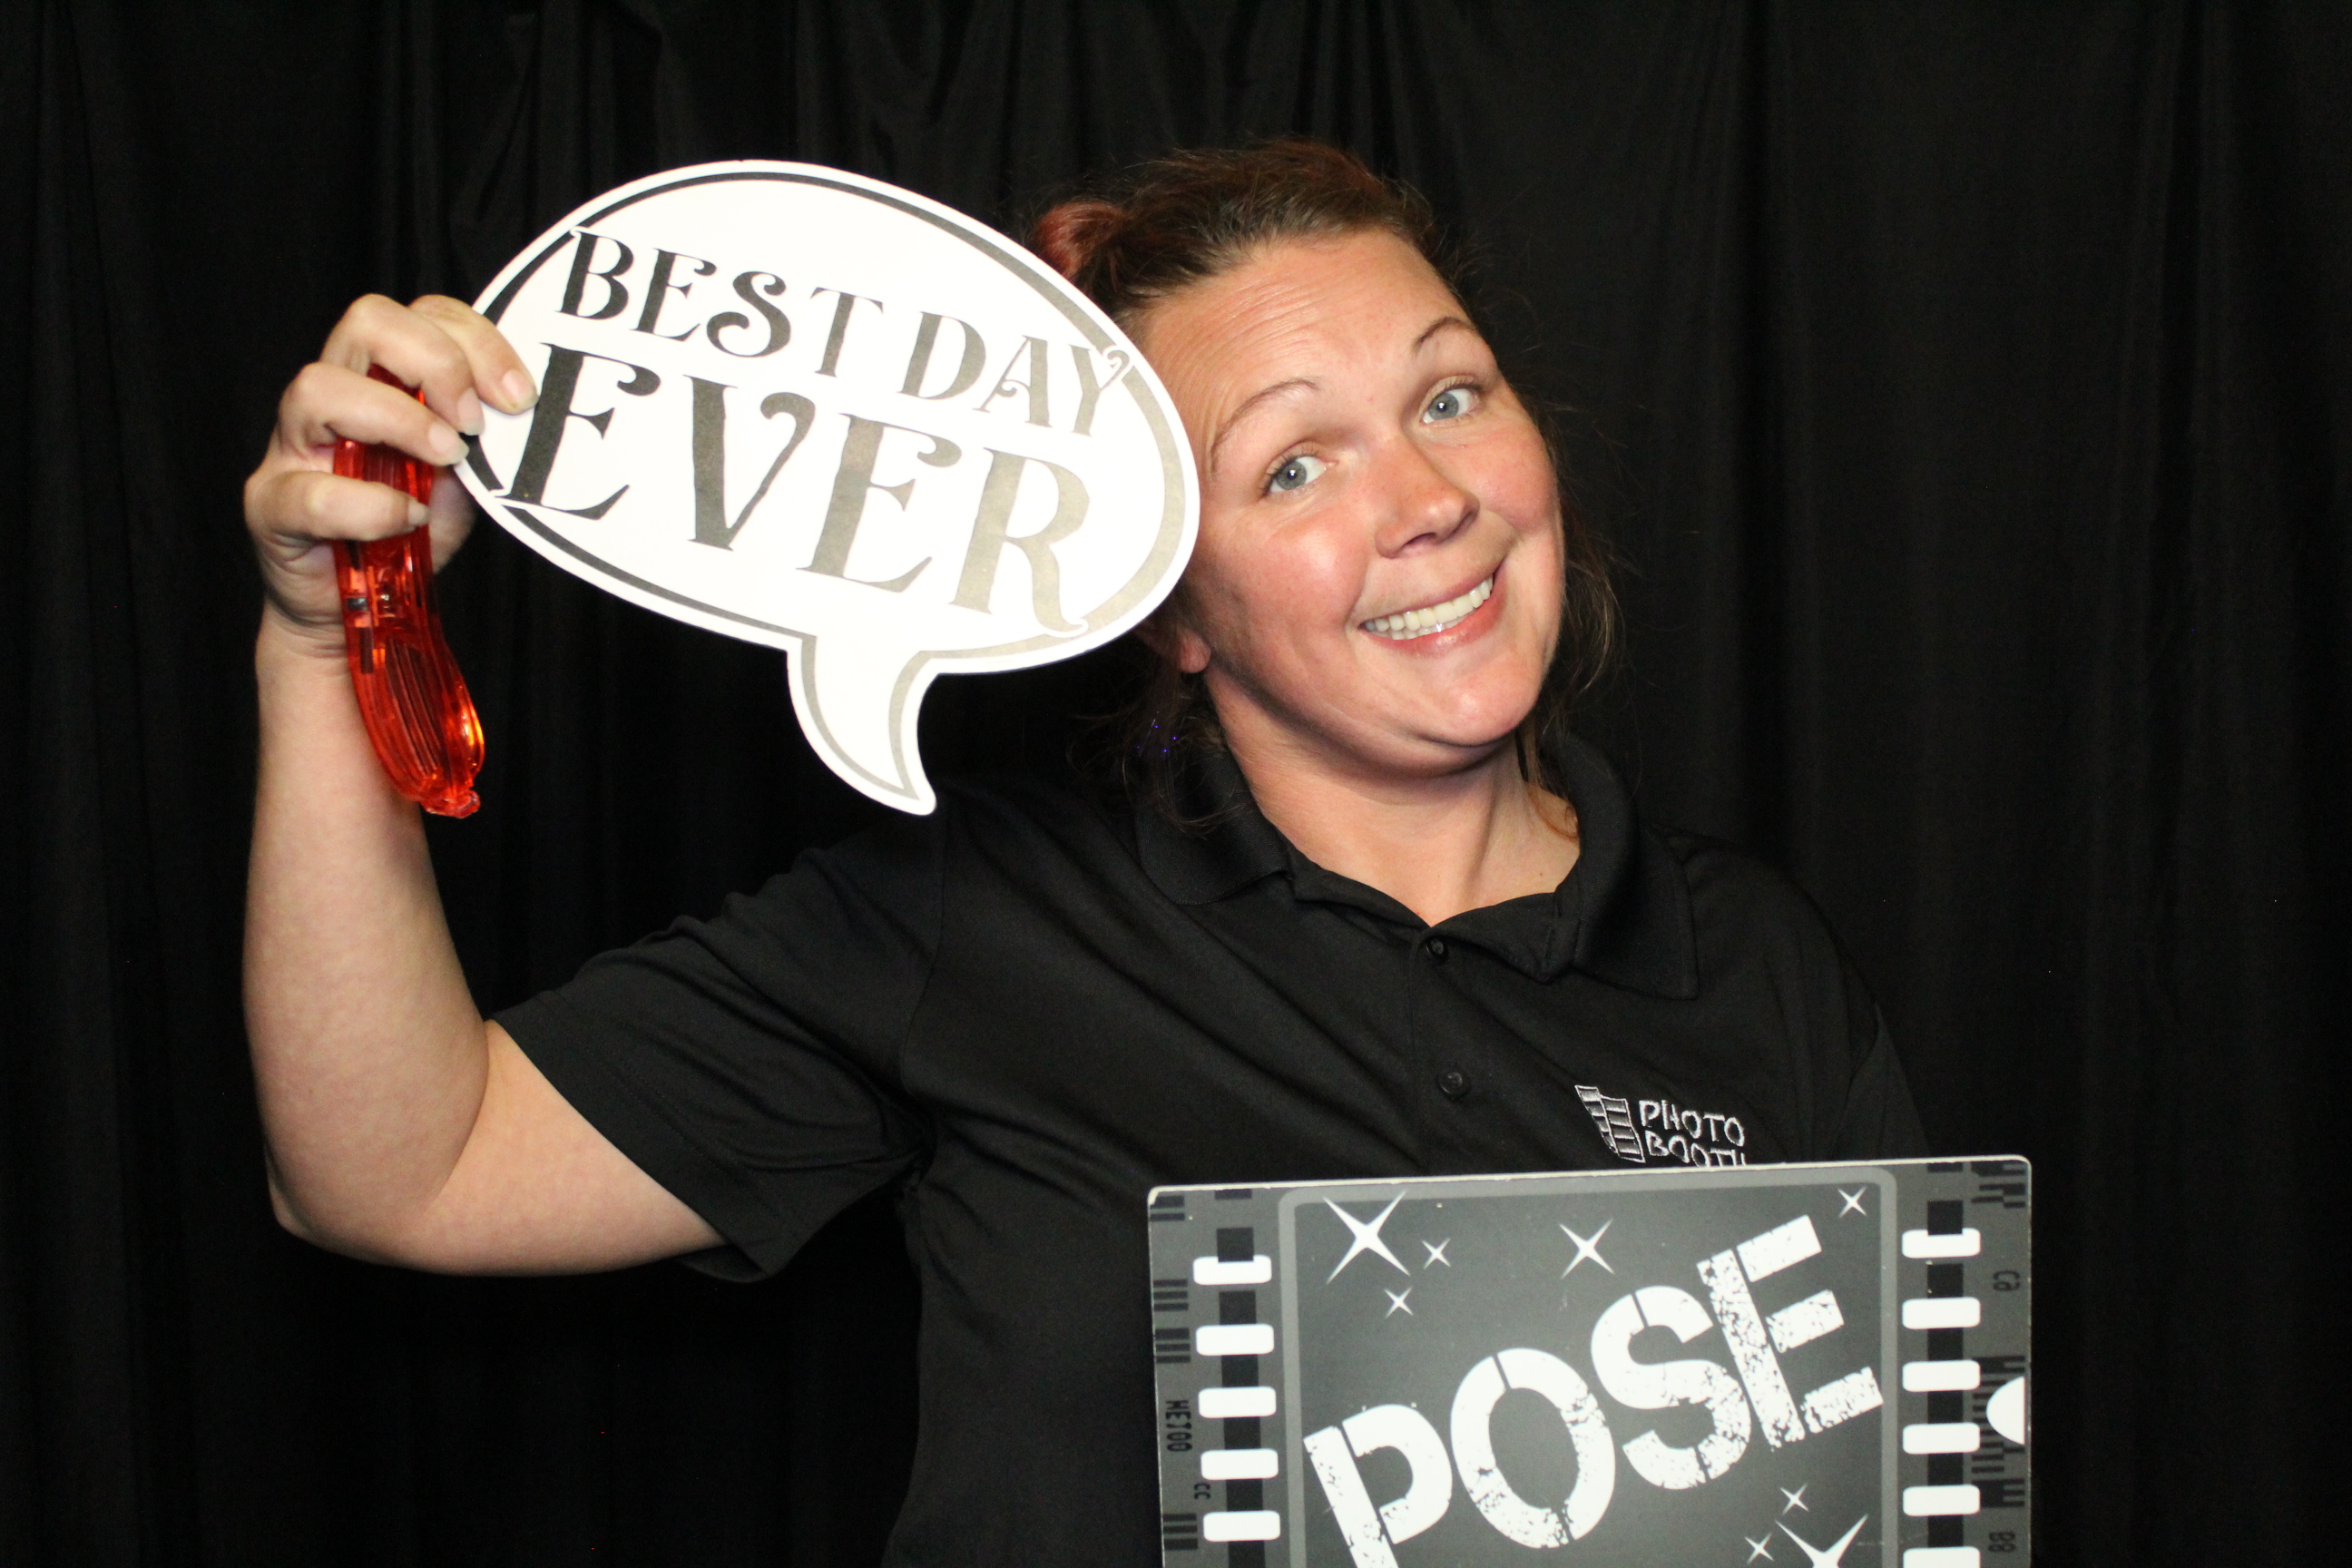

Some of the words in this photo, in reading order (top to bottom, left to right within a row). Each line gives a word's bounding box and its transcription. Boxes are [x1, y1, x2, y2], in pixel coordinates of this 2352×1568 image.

[557, 230, 883, 377] BEST
[898, 311, 1131, 437] DAY
[494, 342, 1089, 635] EVER
[1639, 1099, 1745, 1147] PHOTO
[1303, 1214, 1884, 1568] POSE
